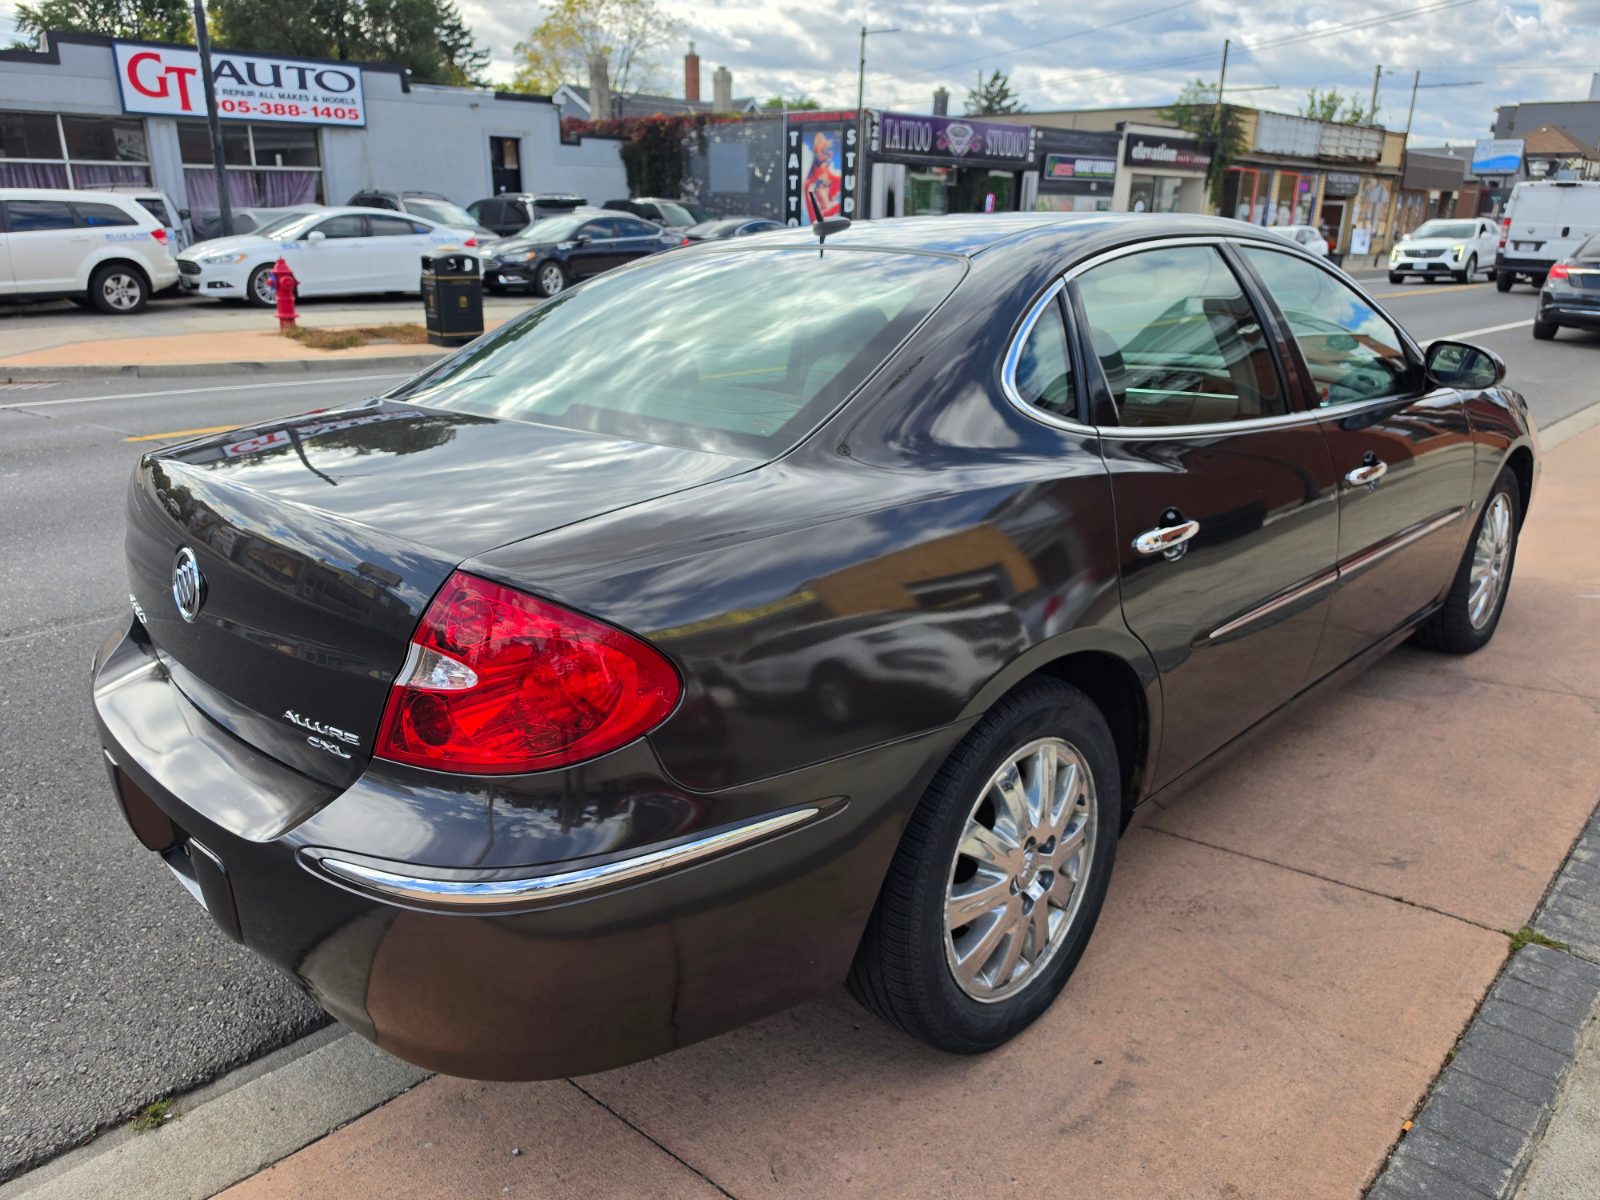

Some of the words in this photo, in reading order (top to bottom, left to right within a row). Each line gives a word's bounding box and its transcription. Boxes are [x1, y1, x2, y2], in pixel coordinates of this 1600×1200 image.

[127, 52, 196, 111] GT
[213, 60, 356, 93] AUTO
[214, 99, 359, 120] 05-388-1405
[222, 88, 255, 97] REPAIR
[259, 90, 274, 99] ALL
[278, 92, 312, 101] MAKES
[322, 96, 356, 105] MODELS
[884, 118, 932, 151] TATTOO
[985, 129, 1027, 158] STUDIO
[283, 710, 360, 746] ALLURE
[306, 736, 351, 759] CXL
